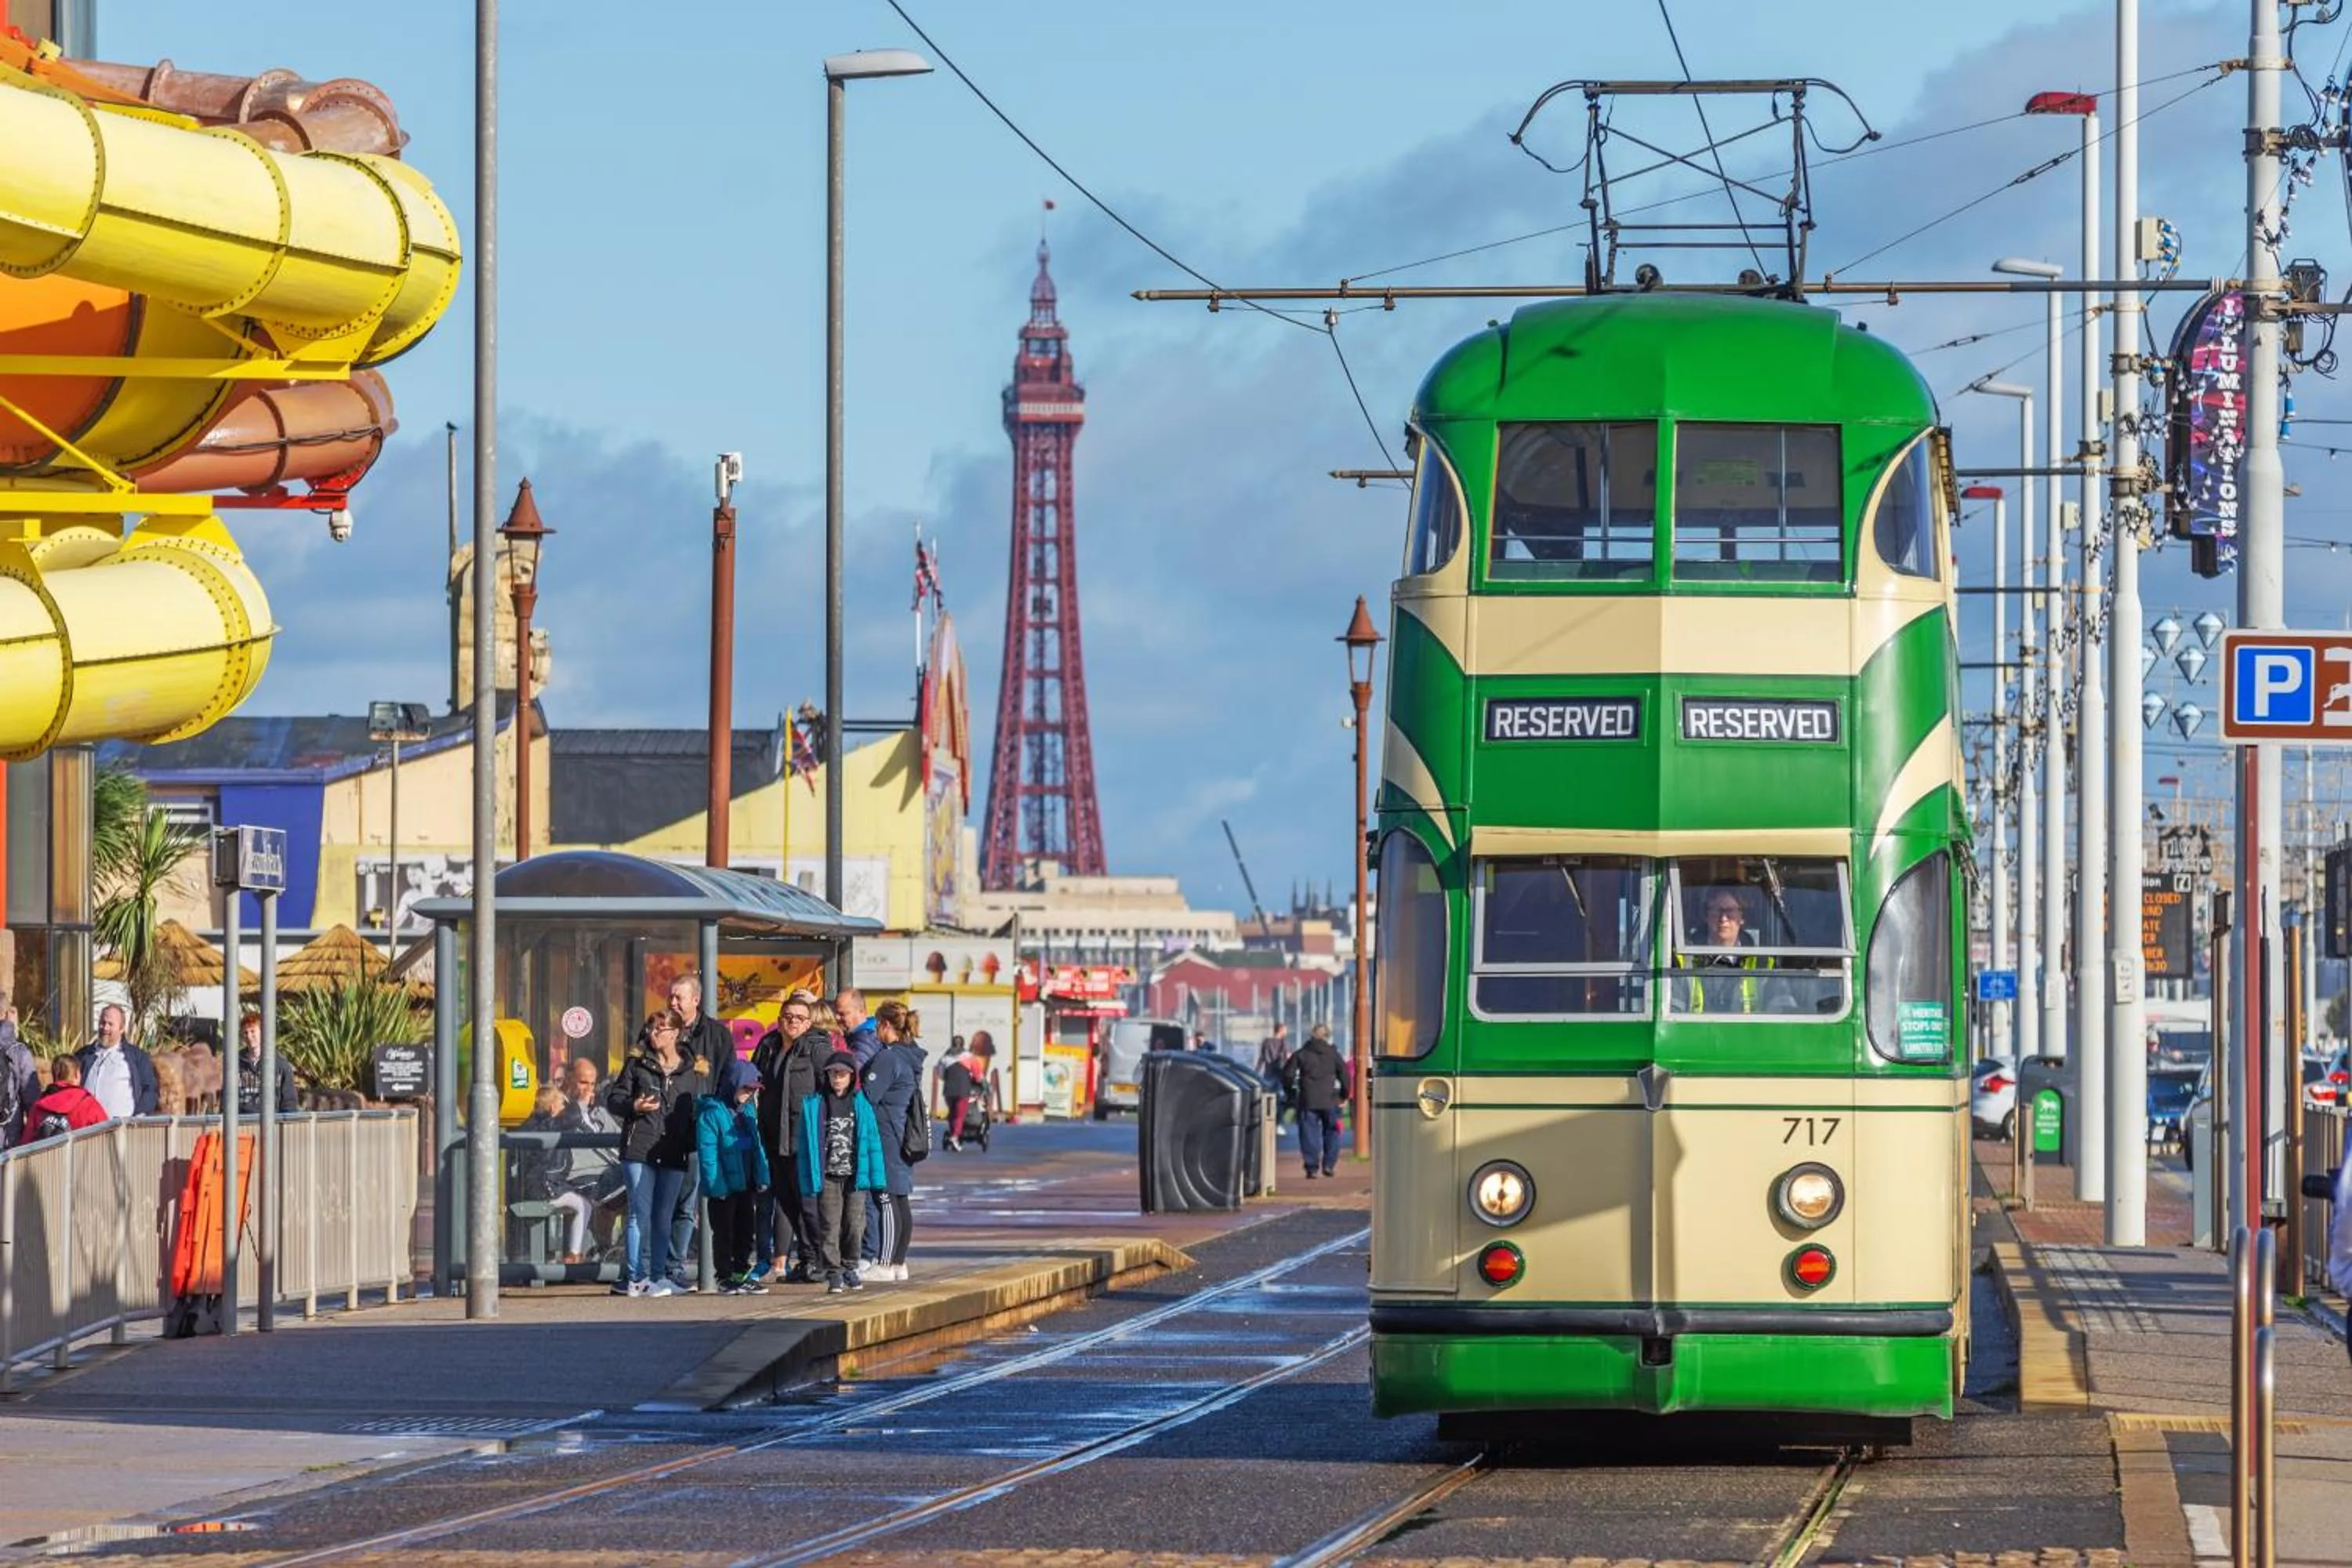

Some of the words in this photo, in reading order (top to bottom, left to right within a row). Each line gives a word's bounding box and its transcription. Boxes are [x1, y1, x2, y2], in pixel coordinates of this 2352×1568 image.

[2254, 655, 2303, 717] P
[1494, 705, 1633, 738] RESERVED
[1689, 707, 1831, 739] RESERVED
[1782, 1117, 1841, 1146] 717
